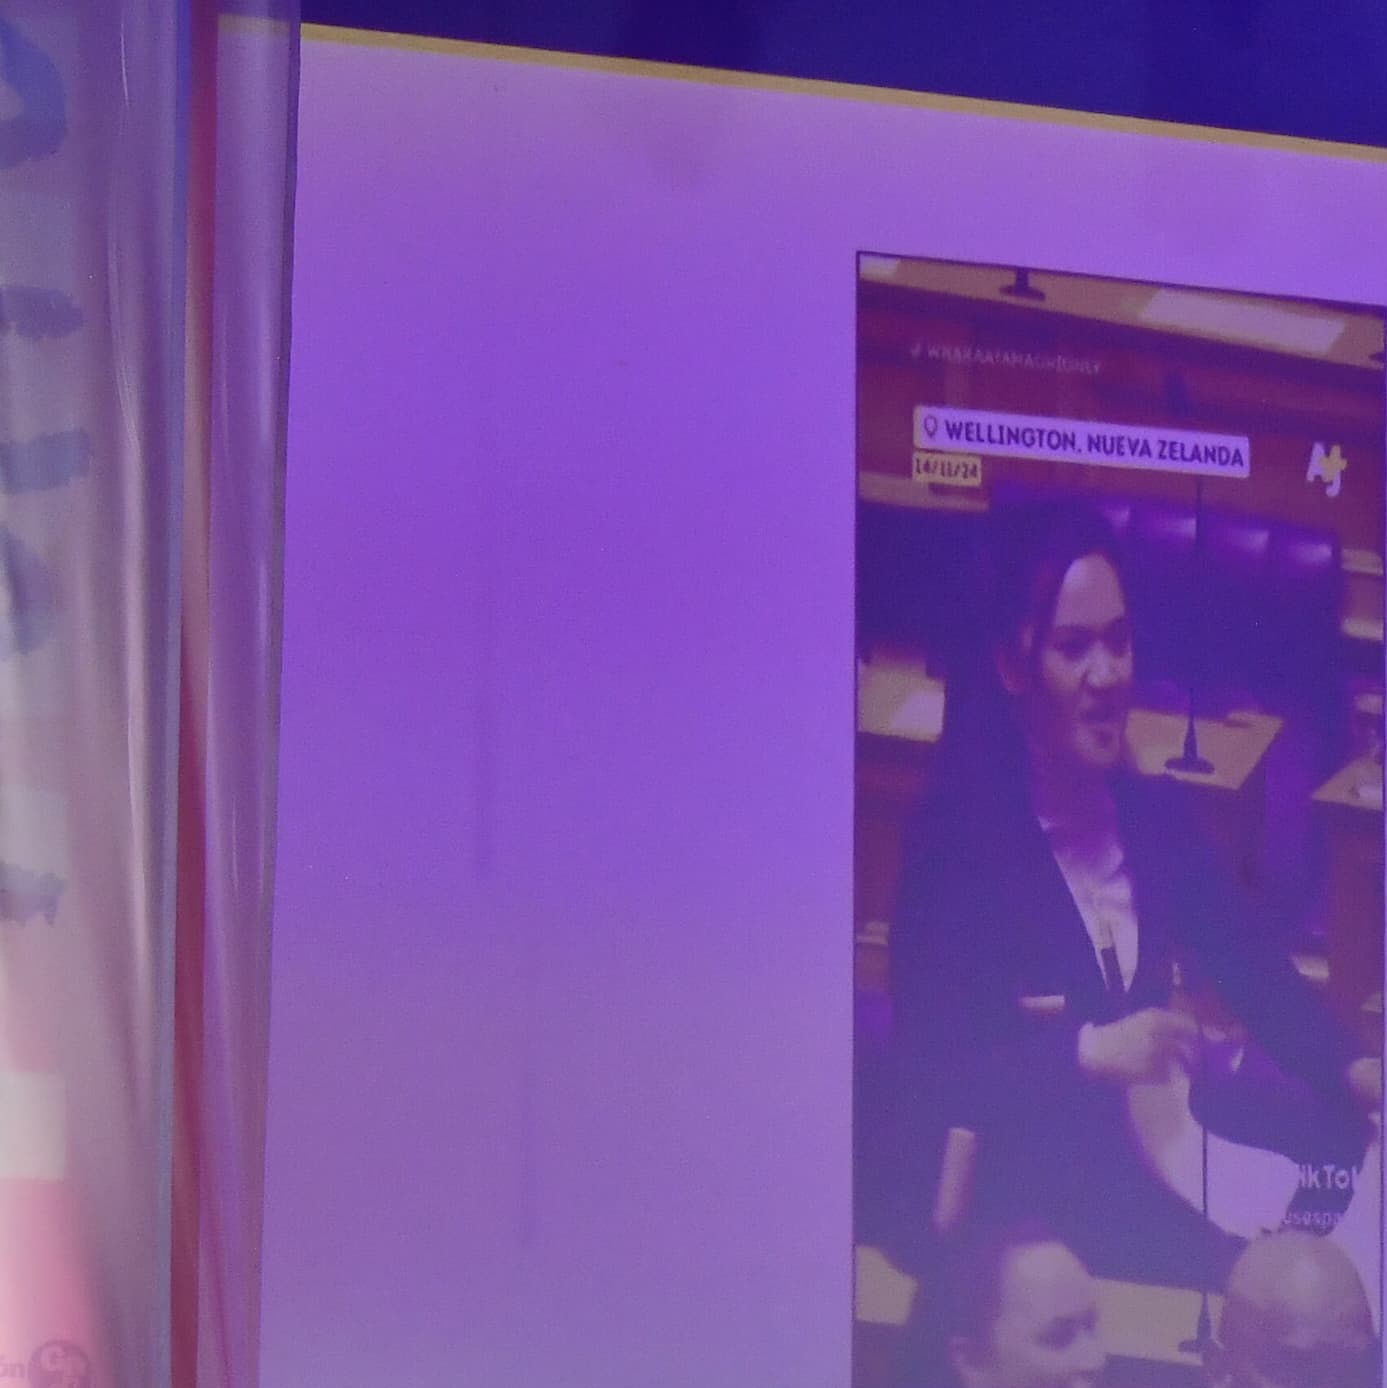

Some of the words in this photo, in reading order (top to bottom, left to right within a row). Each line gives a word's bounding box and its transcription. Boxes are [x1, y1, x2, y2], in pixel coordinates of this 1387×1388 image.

[1087, 433, 1153, 458] NUEVA
[1157, 439, 1245, 468] ZELANDA
[915, 457, 979, 479] 14/11/24
